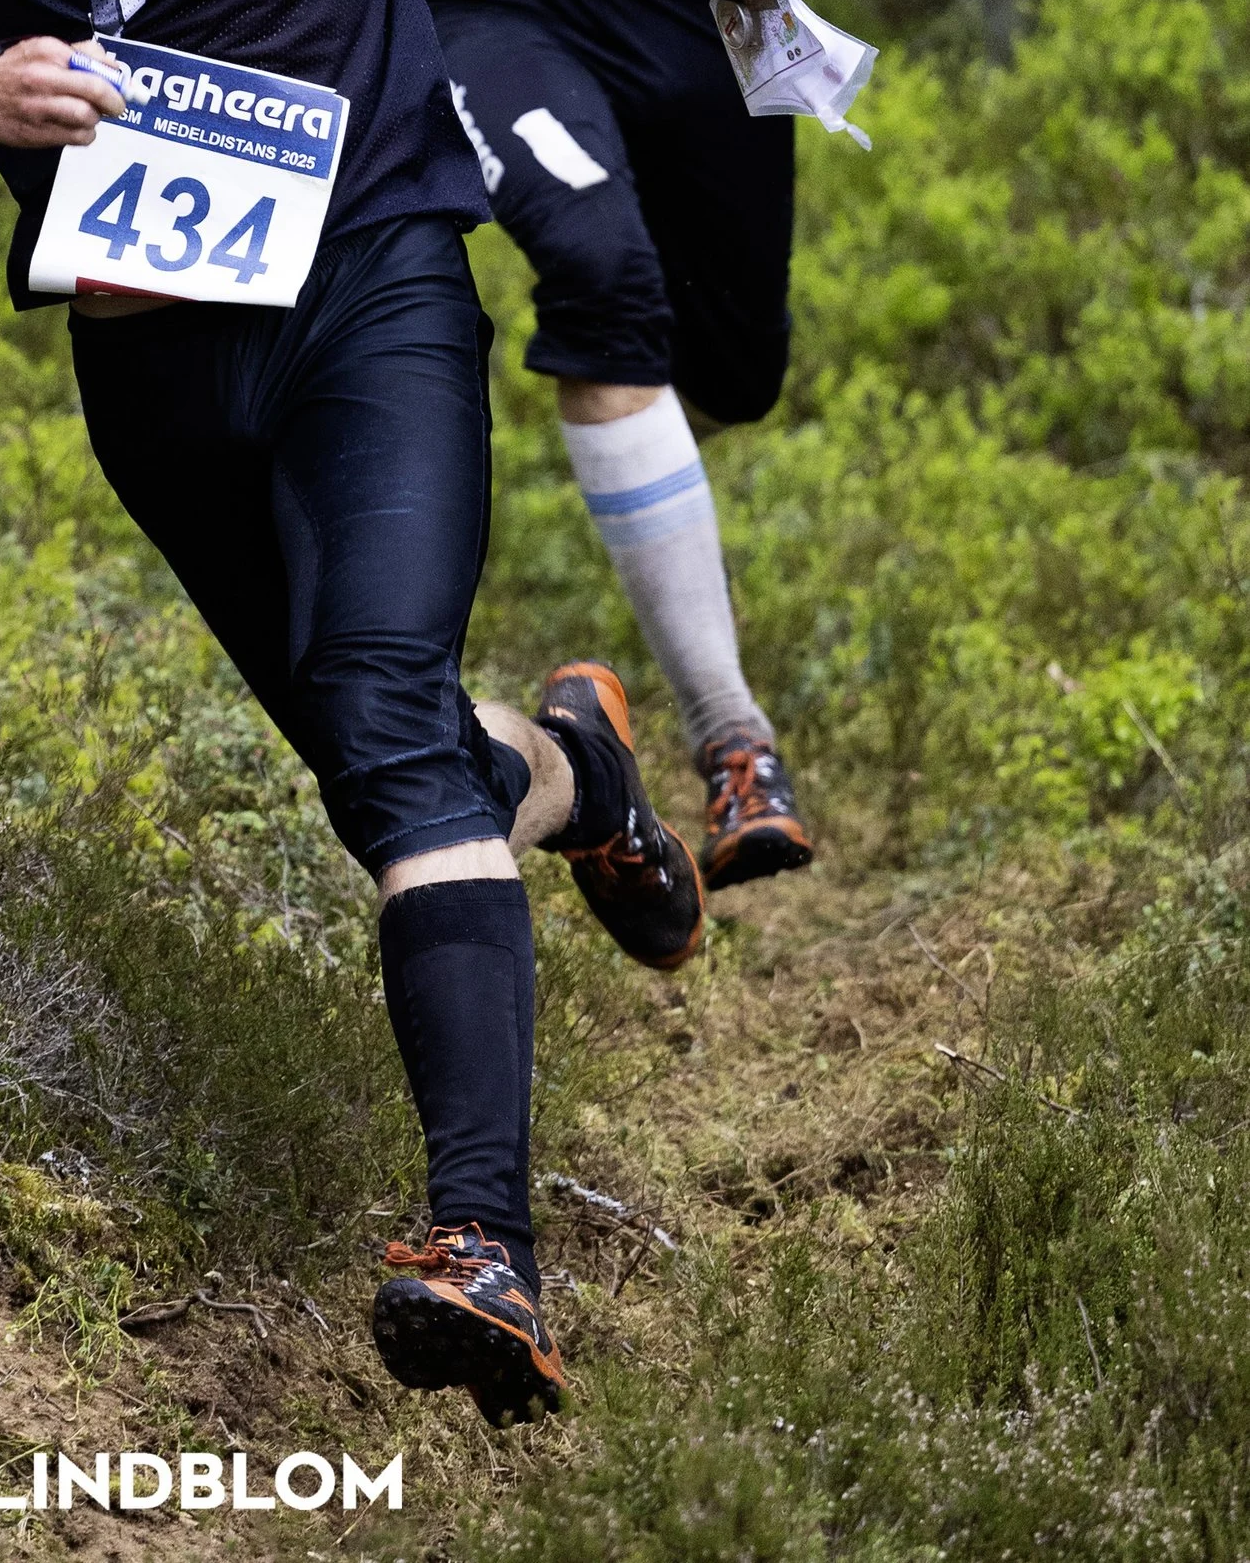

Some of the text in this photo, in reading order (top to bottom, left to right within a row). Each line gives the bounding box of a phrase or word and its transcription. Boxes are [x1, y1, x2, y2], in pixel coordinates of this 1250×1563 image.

[153, 117, 277, 160] MEDELDISTANS
[279, 149, 316, 170] 2025
[78, 162, 277, 285] 434
